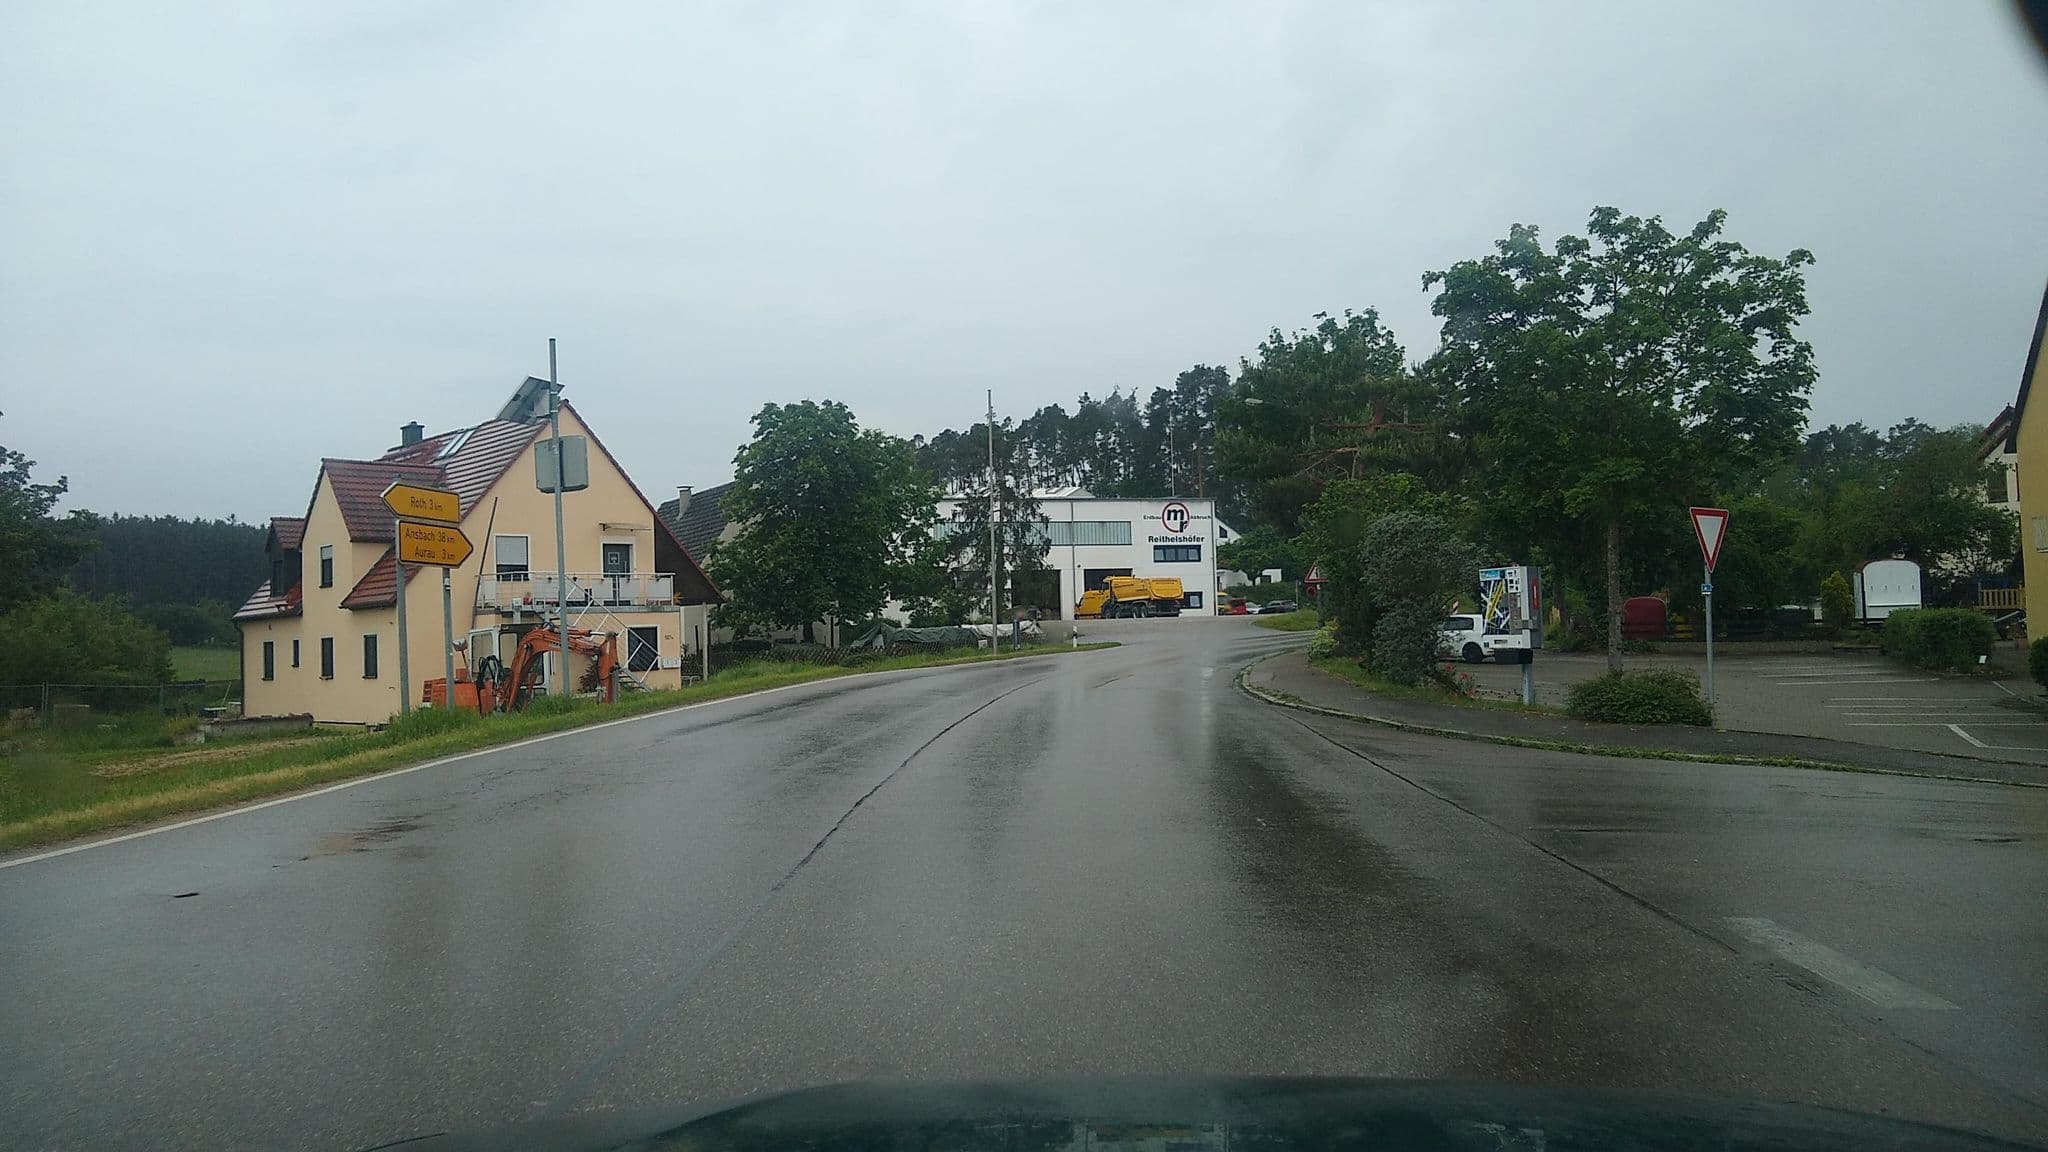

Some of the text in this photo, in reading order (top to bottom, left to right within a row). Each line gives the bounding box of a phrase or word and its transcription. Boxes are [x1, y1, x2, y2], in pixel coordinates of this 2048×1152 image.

[410, 496, 443, 511] Roth 3 km
[405, 527, 435, 541] Ansbach
[438, 531, 446, 543] 38
[1148, 535, 1205, 543] Reithelshöfer
[415, 546, 456, 560] Aurau 3 km
